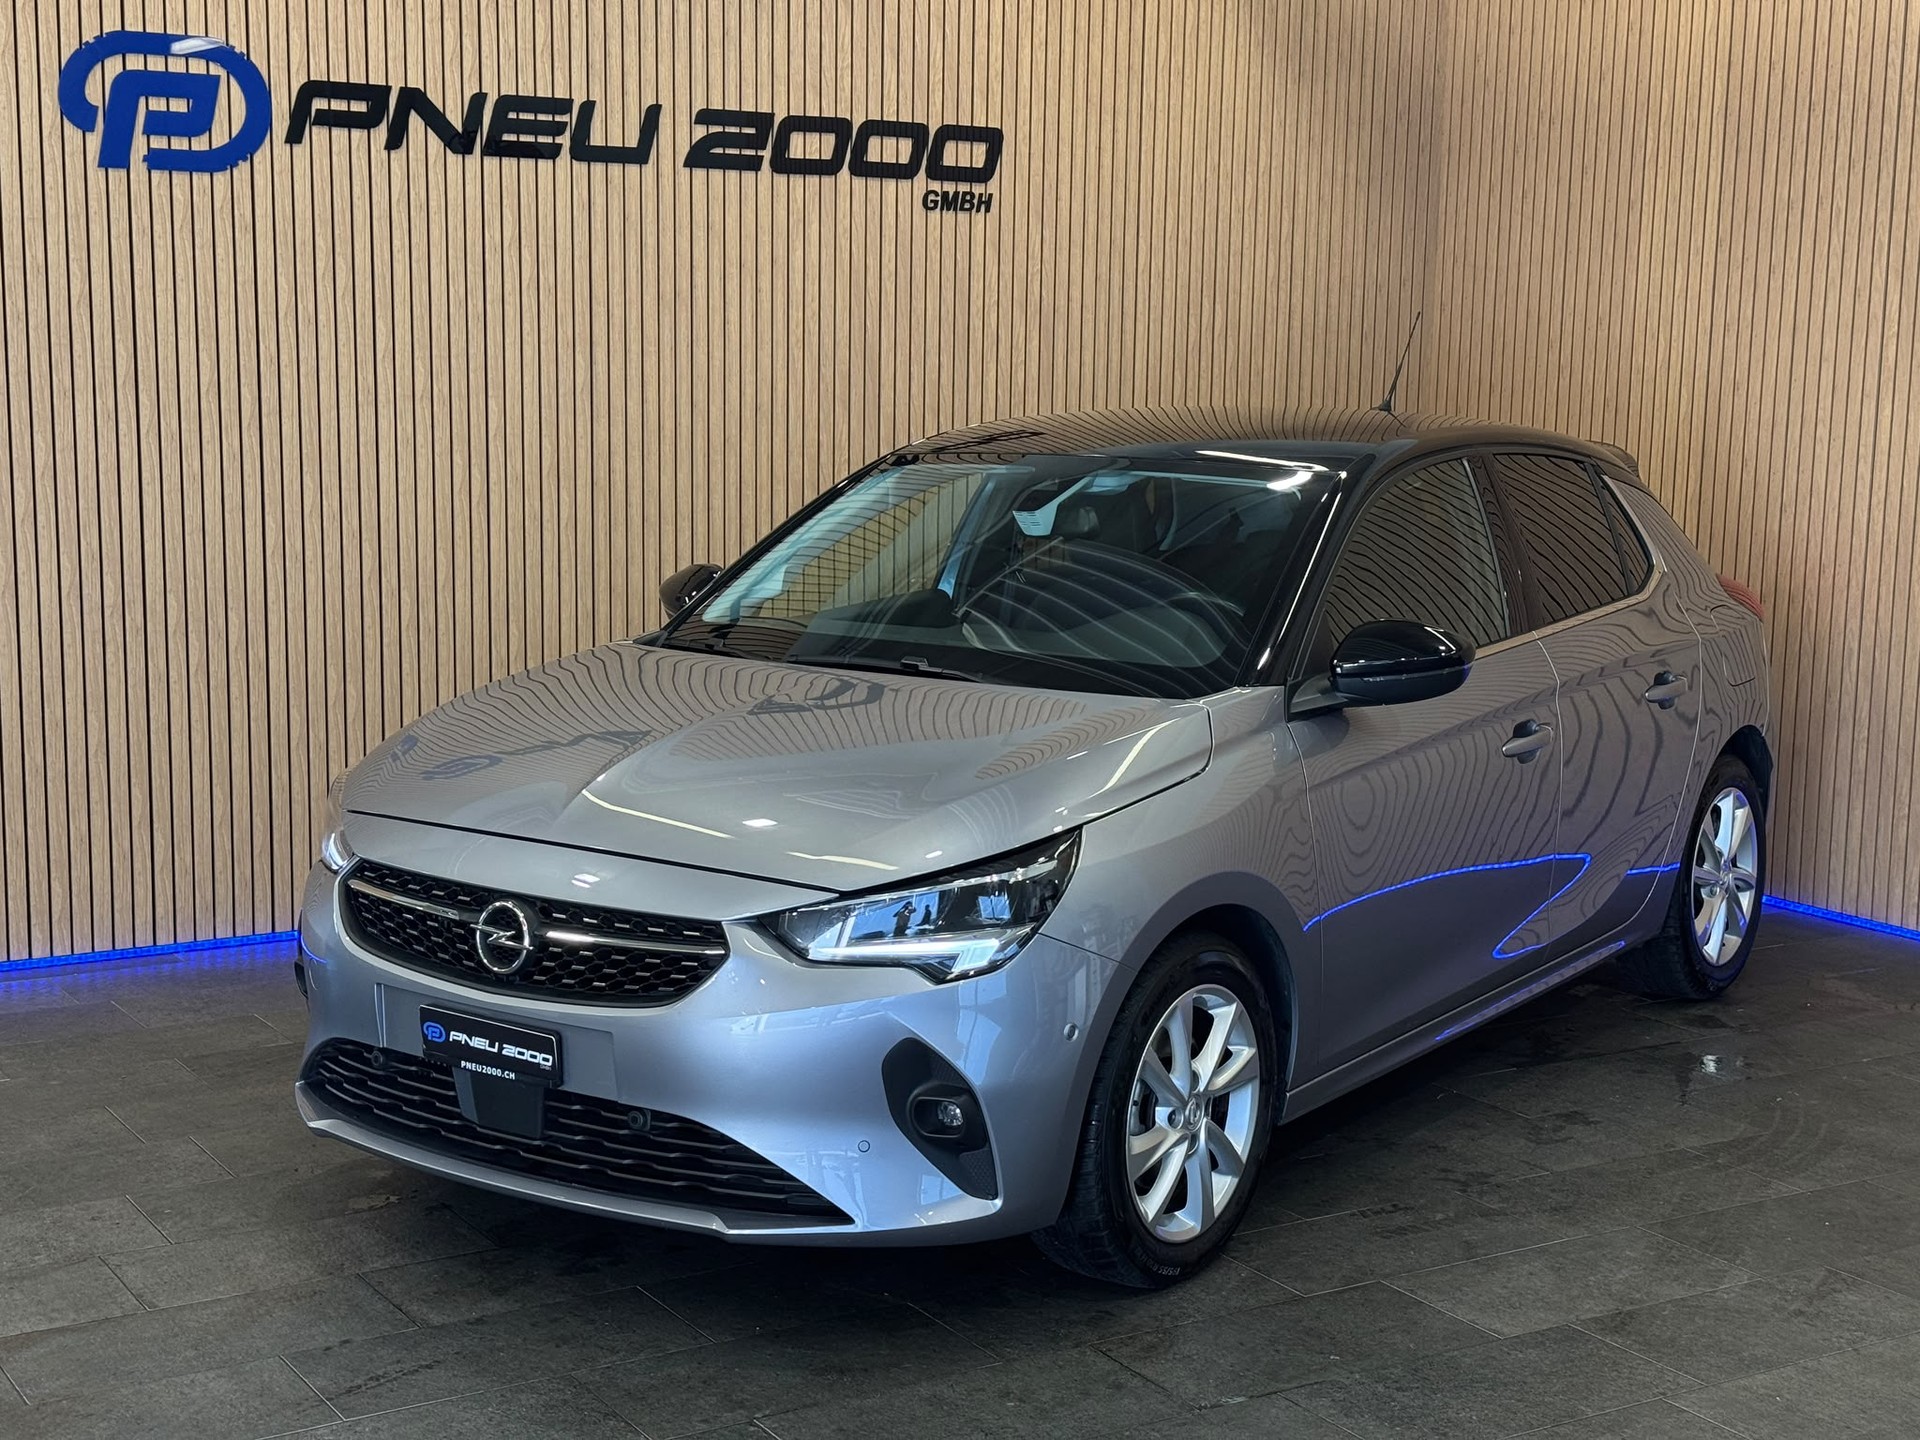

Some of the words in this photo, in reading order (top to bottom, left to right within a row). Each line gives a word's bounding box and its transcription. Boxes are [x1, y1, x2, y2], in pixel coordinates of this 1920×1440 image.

[284, 79, 662, 165] PNEU
[683, 108, 1004, 184] 2000
[921, 189, 994, 214] GMBH
[449, 1030, 499, 1053] PNEU
[501, 1044, 553, 1065] 2000
[460, 1060, 516, 1080] PNEU2000.CH
